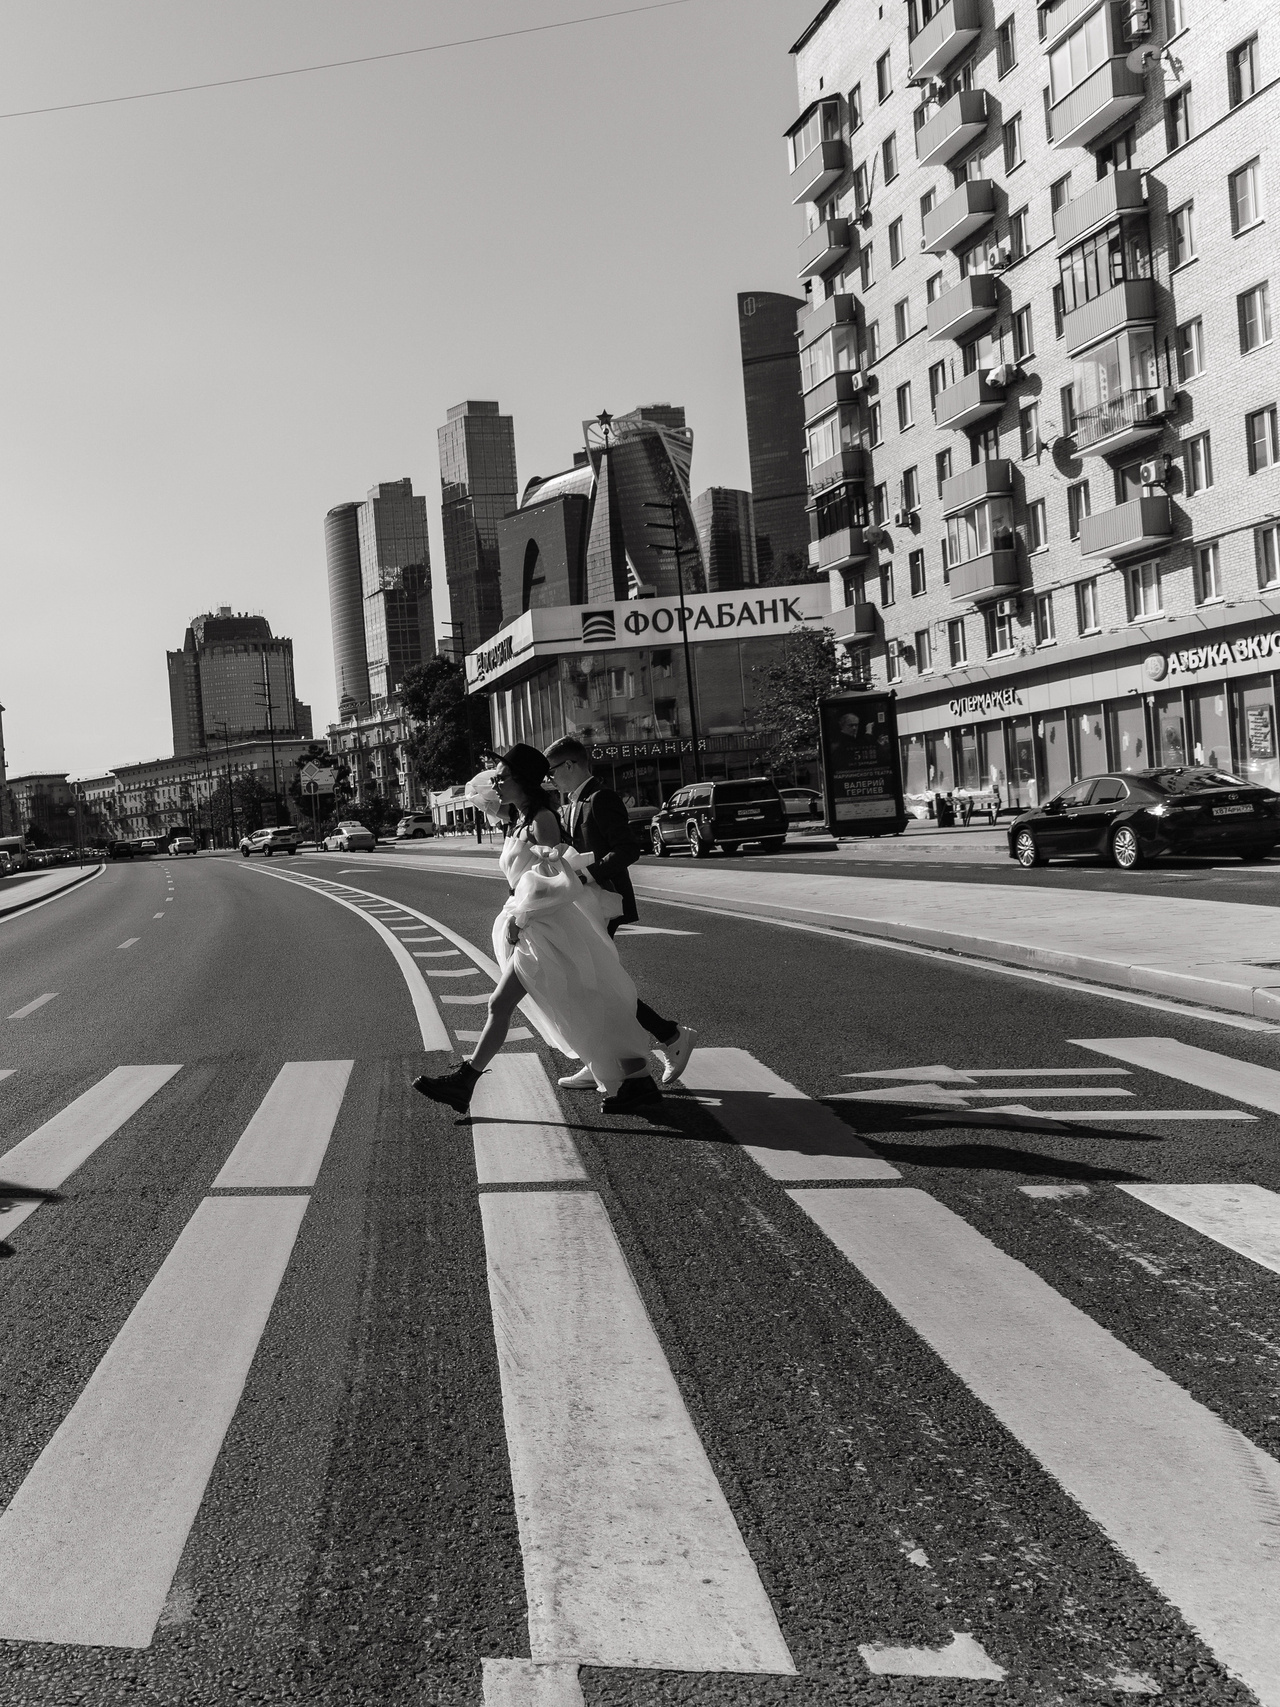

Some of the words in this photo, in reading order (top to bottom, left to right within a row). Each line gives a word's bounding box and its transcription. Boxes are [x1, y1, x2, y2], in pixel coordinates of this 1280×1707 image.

[624, 596, 803, 636] ФОРАБАНК
[1168, 641, 1232, 674] АЗБУКА
[949, 687, 1016, 716] СУПЕРМАРКЕТ
[591, 739, 706, 760] ОФЕМАНИЯ
[844, 778, 885, 789] ВАЛЕРИЙ
[846, 786, 884, 796] ГЕРГИЕВ
